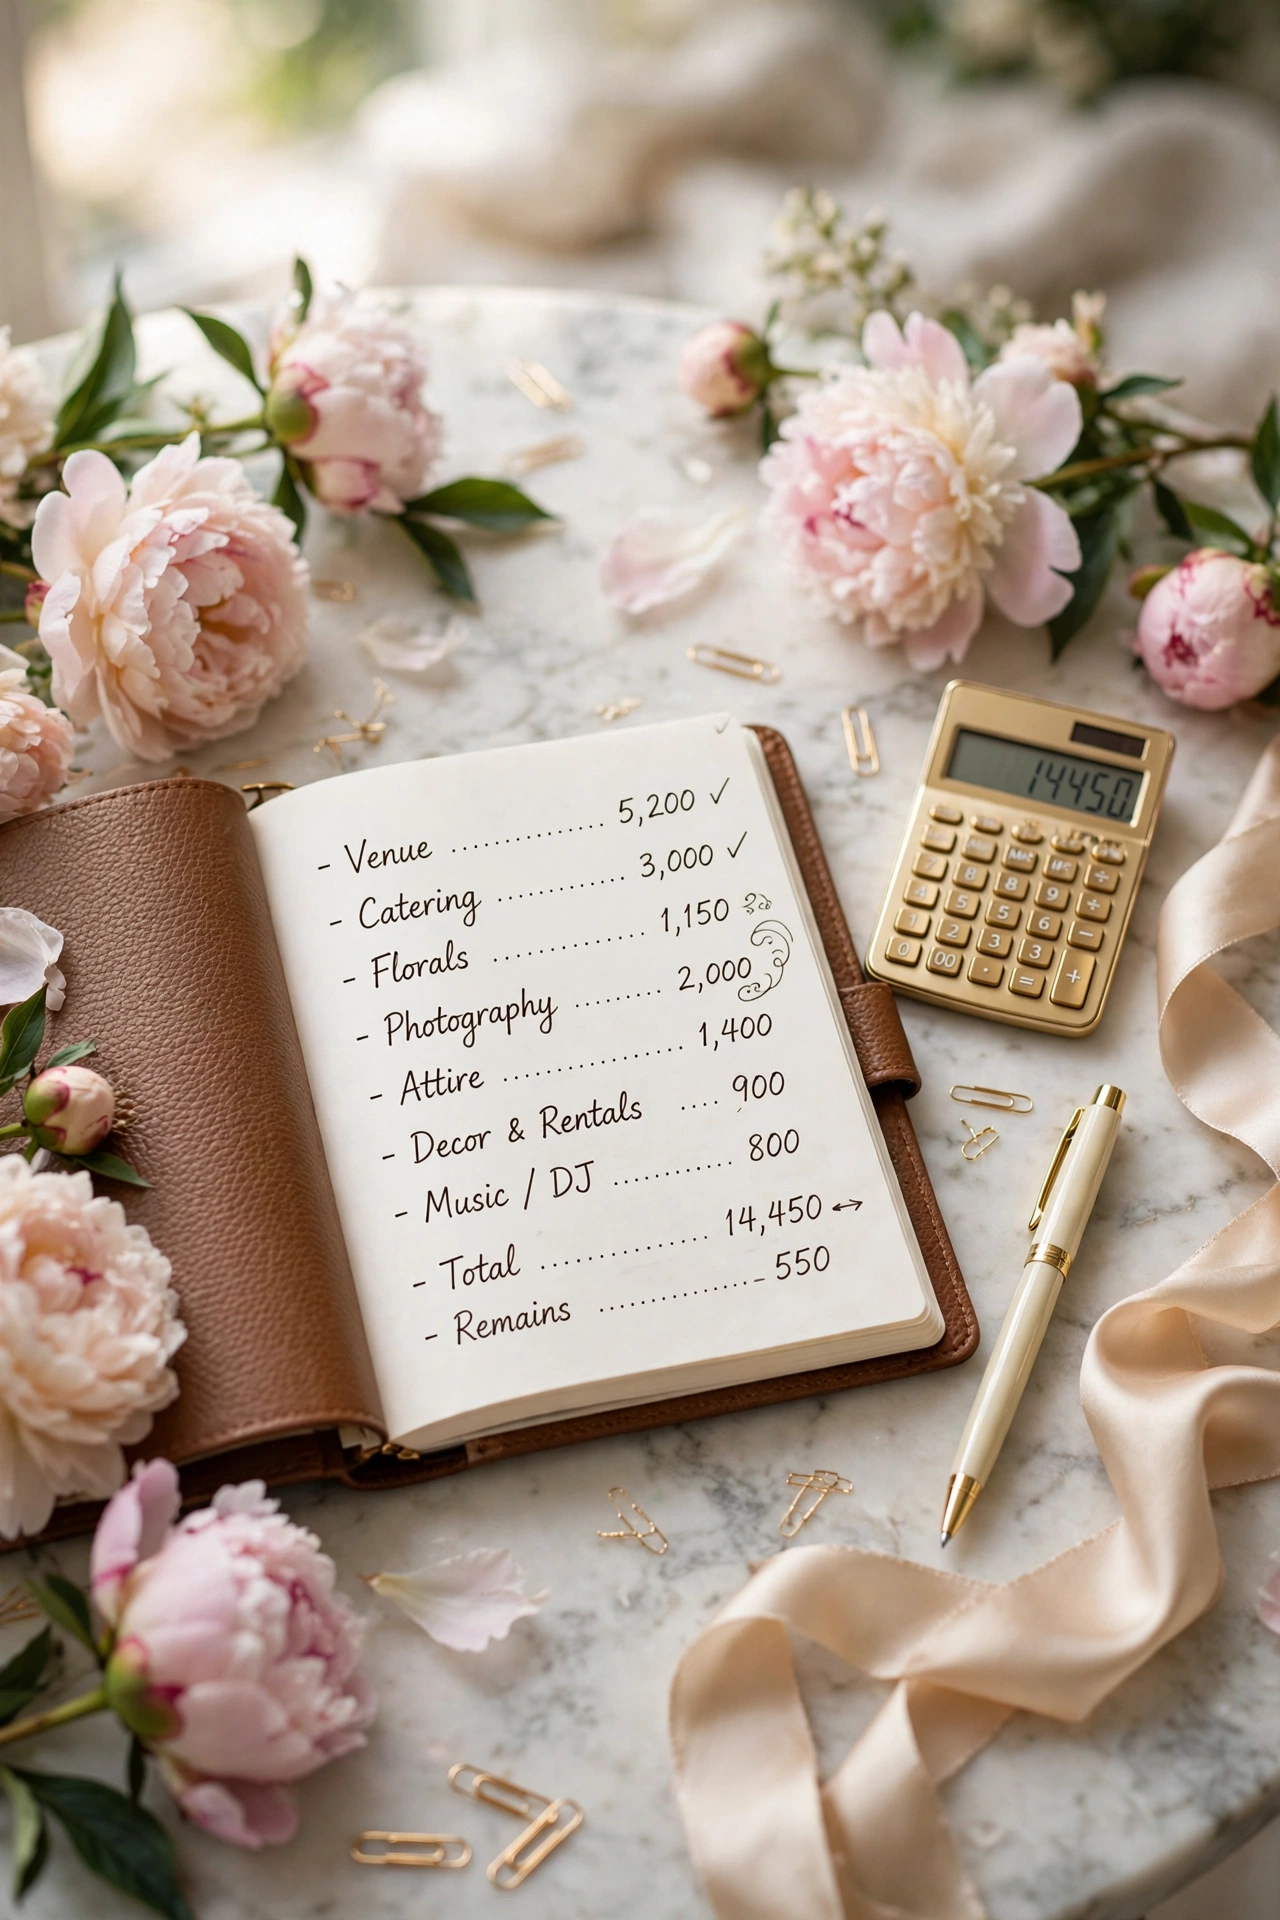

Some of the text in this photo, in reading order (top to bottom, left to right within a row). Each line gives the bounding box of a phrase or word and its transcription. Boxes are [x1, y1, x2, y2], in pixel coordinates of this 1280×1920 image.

[343, 789, 695, 874] Venue 5,200
[1028, 760, 1133, 818] 14450
[359, 844, 714, 929] Catering 3,000
[915, 886, 1050, 930] 4 5 5 6
[964, 867, 977, 881] 8
[1005, 877, 1018, 891] 8
[1047, 887, 1059, 901] 9
[370, 898, 730, 989] Florals 1,150
[898, 942, 956, 967] 0 00
[908, 914, 1042, 959] 1 2 3 3
[383, 956, 752, 1049] Photography 2,000
[400, 1013, 773, 1106] Attire 1,400
[410, 1071, 785, 1164] Decor & Rentals 900
[425, 1128, 800, 1224] Music / DJ 800
[438, 1194, 822, 1290] Total 14,450
[453, 1245, 830, 1346] Remains 550
